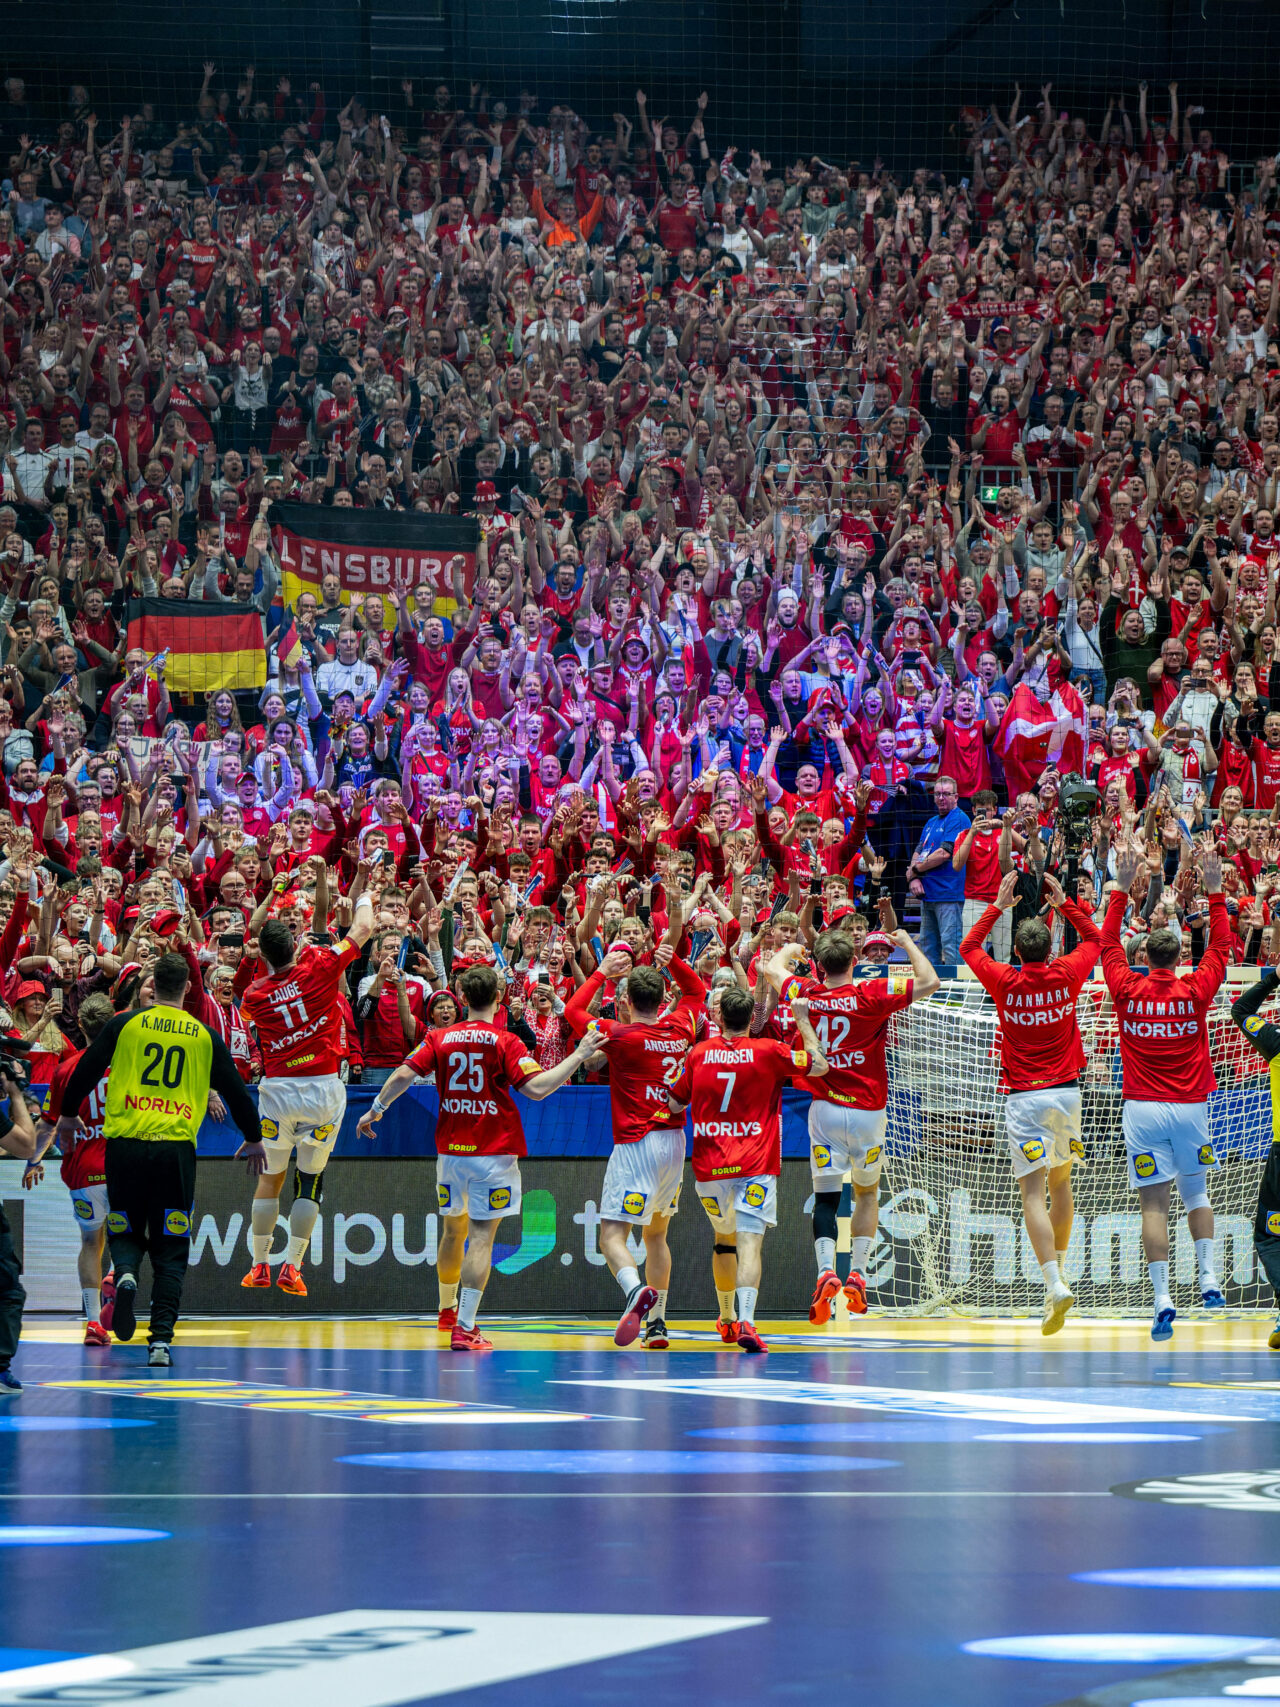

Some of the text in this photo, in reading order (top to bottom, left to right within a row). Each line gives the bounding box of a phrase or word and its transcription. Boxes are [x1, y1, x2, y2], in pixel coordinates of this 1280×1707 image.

[267, 980, 303, 1005] LAUGE
[1006, 986, 1071, 1007] DANMARK
[273, 996, 310, 1030] 11
[1003, 1002, 1074, 1026] NORLYS
[1127, 1000, 1196, 1016] DANMARK
[141, 1014, 200, 1038] K.MØLLER
[815, 1014, 852, 1055] 42
[1123, 1019, 1199, 1038] NORLYS
[441, 1029, 499, 1046] JØRGENSEN
[140, 1041, 187, 1090] 20
[286, 1053, 316, 1069] BORUP
[702, 1048, 754, 1065] JAKOBSEN
[448, 1050, 485, 1094] 25
[716, 1071, 737, 1113] 7
[828, 1090, 857, 1103] BORUP
[125, 1093, 193, 1121] NORLYS
[440, 1099, 499, 1116] NORLYS
[693, 1121, 763, 1138] NORLYS
[448, 1143, 478, 1152] BORUP
[711, 1165, 742, 1176] BORUP
